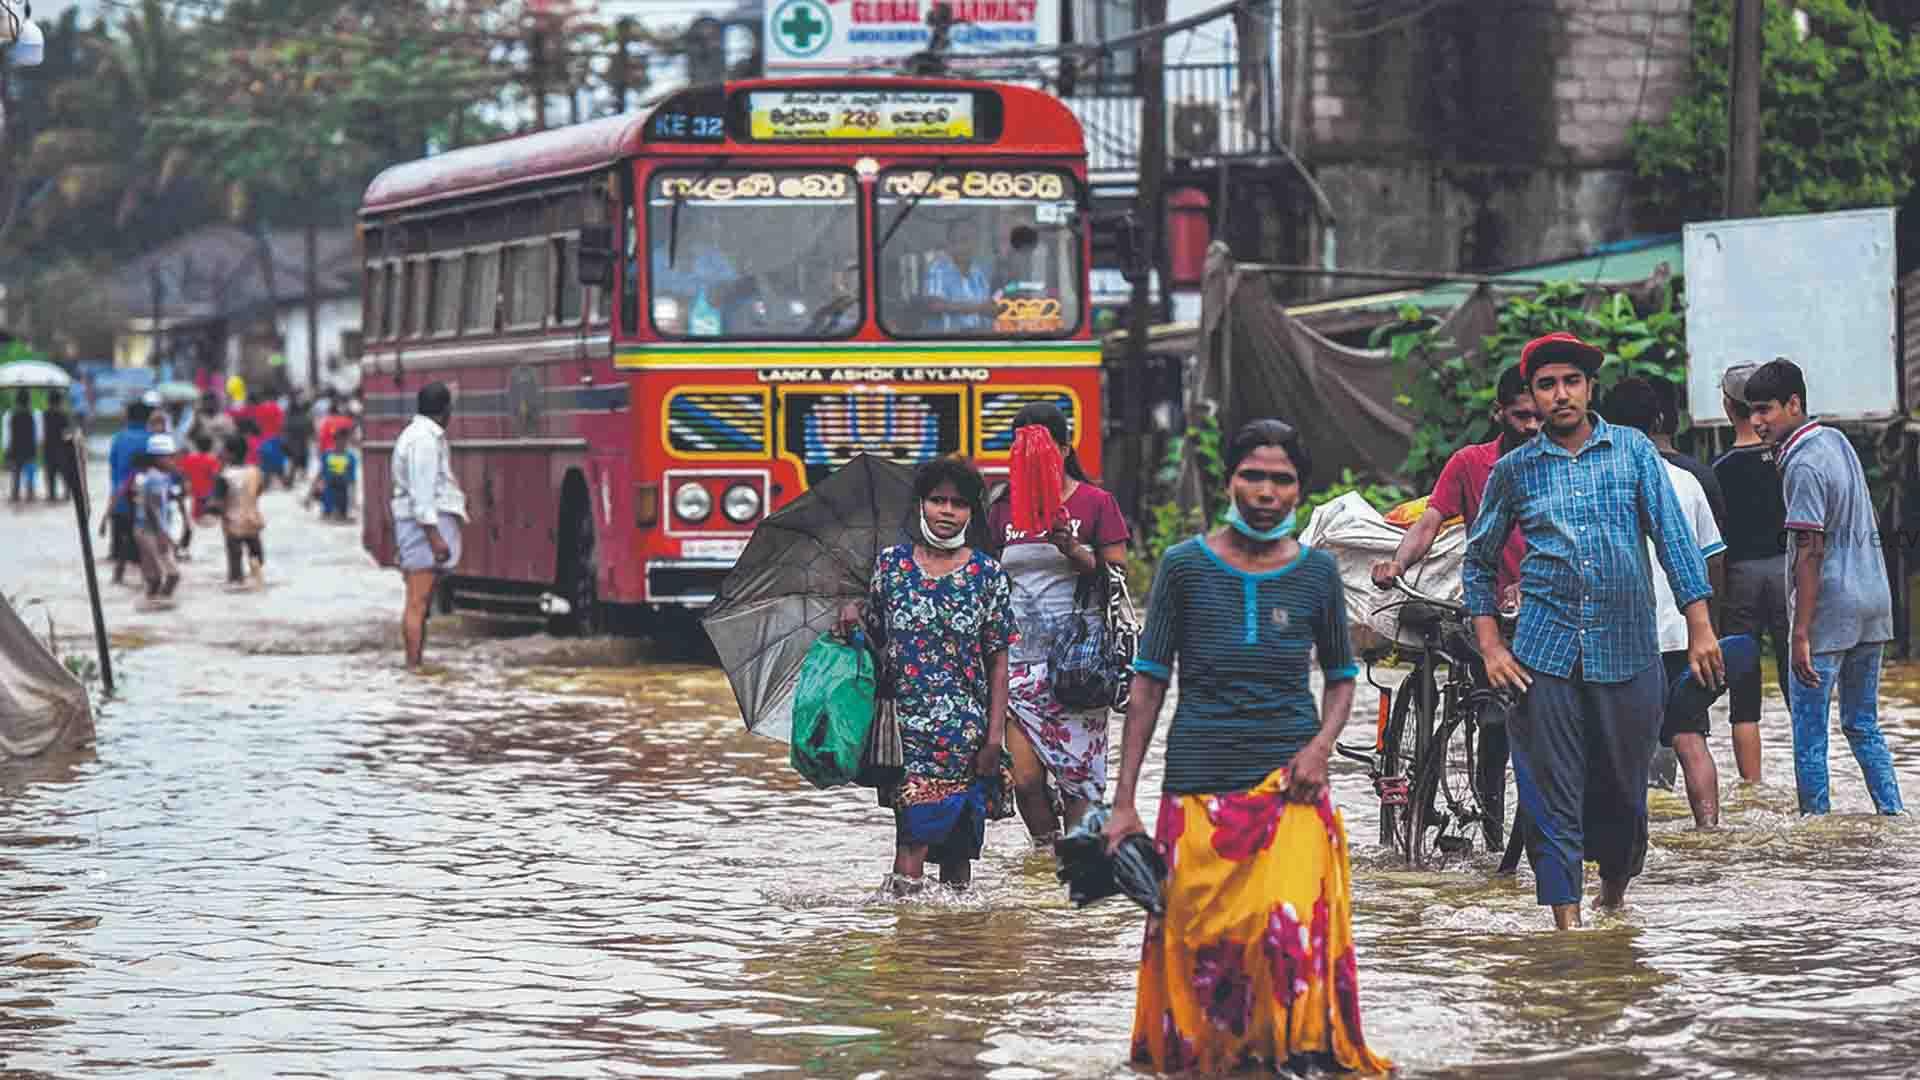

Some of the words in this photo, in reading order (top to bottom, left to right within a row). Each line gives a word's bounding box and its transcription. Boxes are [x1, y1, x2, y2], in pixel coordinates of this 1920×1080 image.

[692, 115, 725, 136] 32
[758, 369, 822, 382] LANKA
[831, 369, 896, 382] ASHOK
[903, 369, 990, 382] LEYLAND
